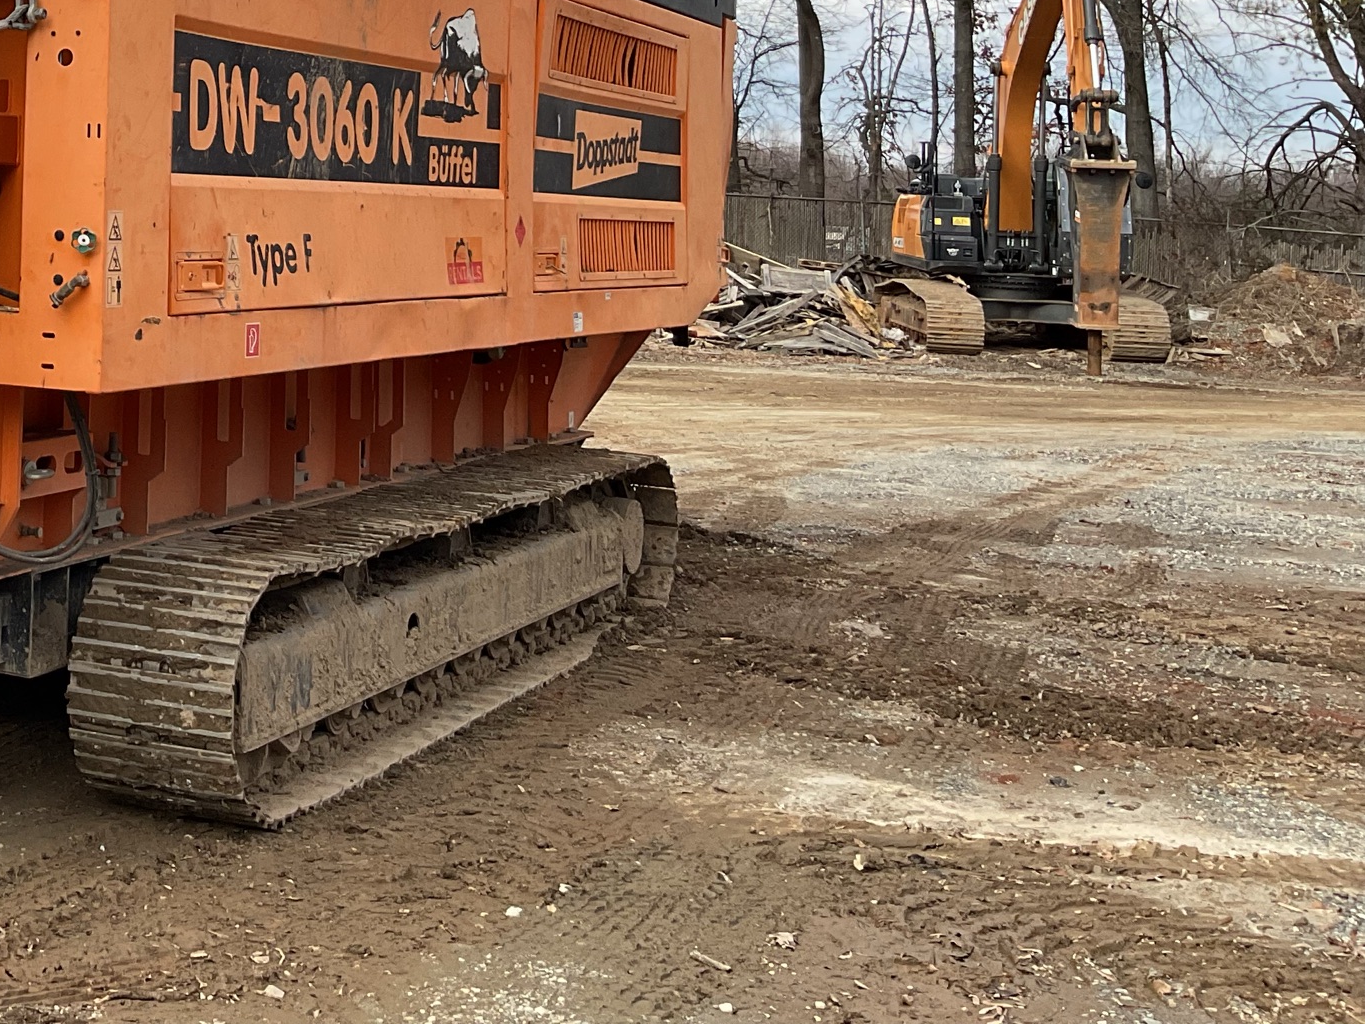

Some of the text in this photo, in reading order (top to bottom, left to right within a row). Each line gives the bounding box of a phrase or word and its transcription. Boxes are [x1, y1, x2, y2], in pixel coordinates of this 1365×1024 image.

[392, 87, 414, 166] K
[576, 127, 640, 176] Doppstadt
[428, 145, 478, 185] Büffel
[245, 233, 312, 287] Type F
